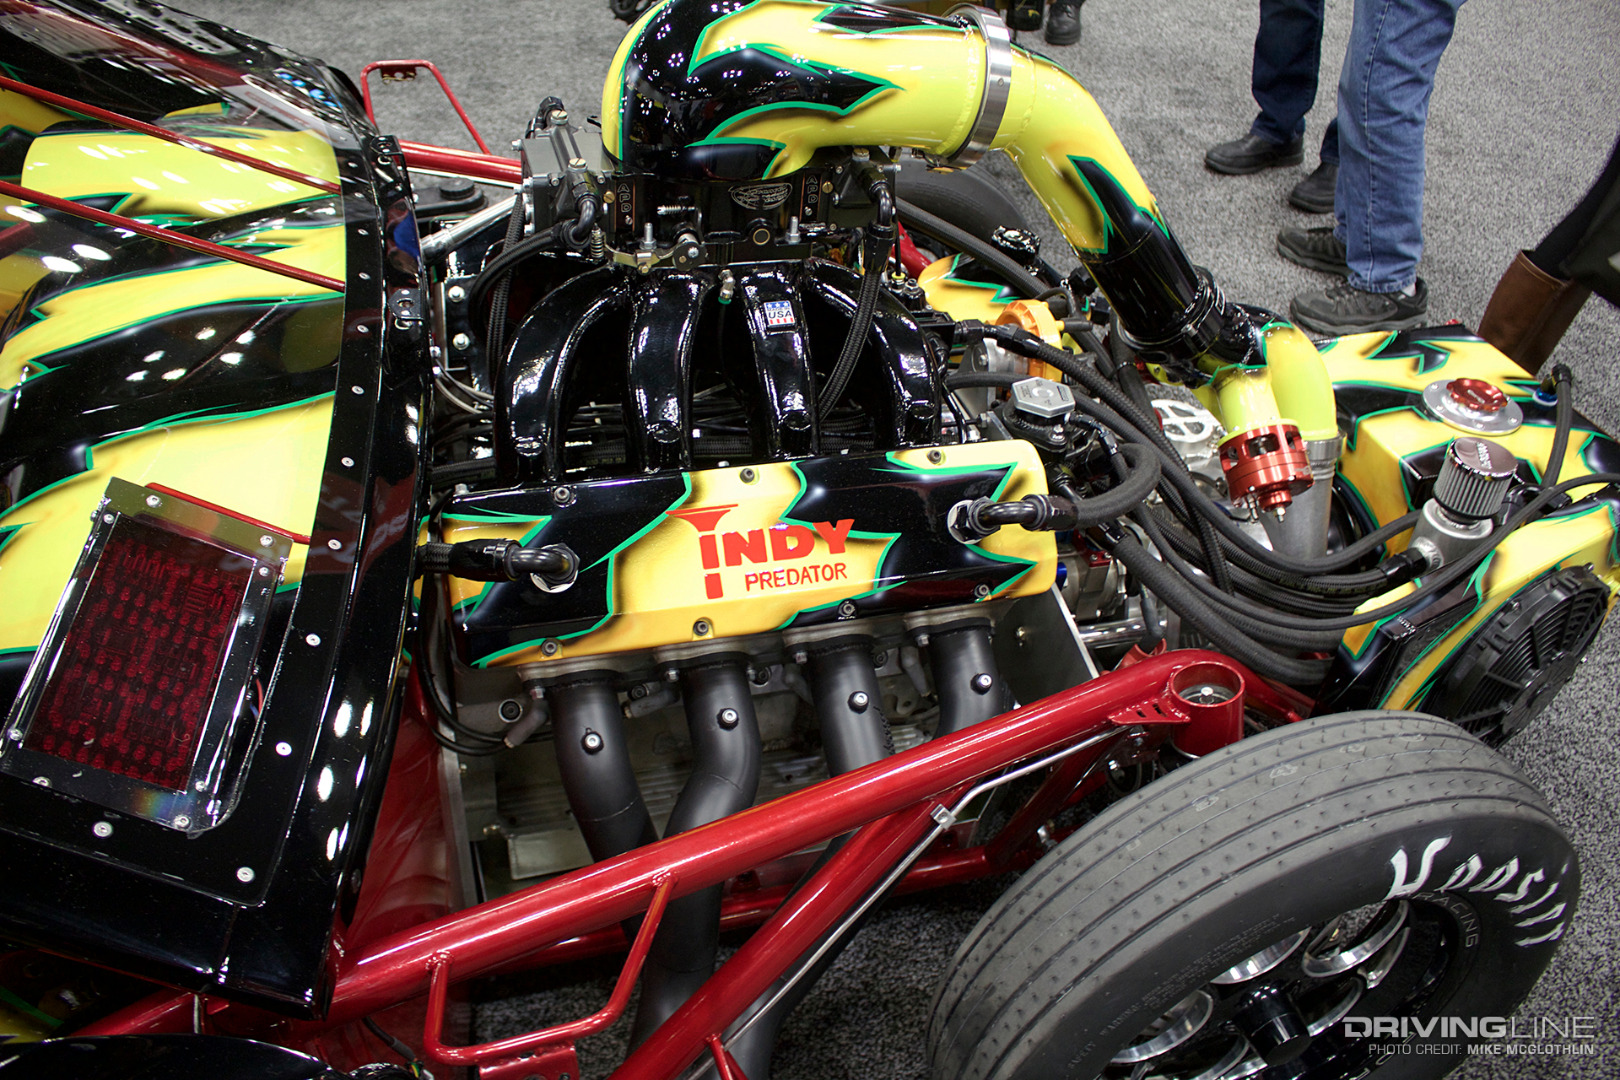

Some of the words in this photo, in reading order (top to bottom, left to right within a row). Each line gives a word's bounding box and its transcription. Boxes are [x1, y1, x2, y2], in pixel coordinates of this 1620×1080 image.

[768, 310, 793, 319] USA
[690, 510, 856, 599] INDY
[745, 562, 848, 592] PREDATOR
[1411, 891, 1480, 948] RACING
